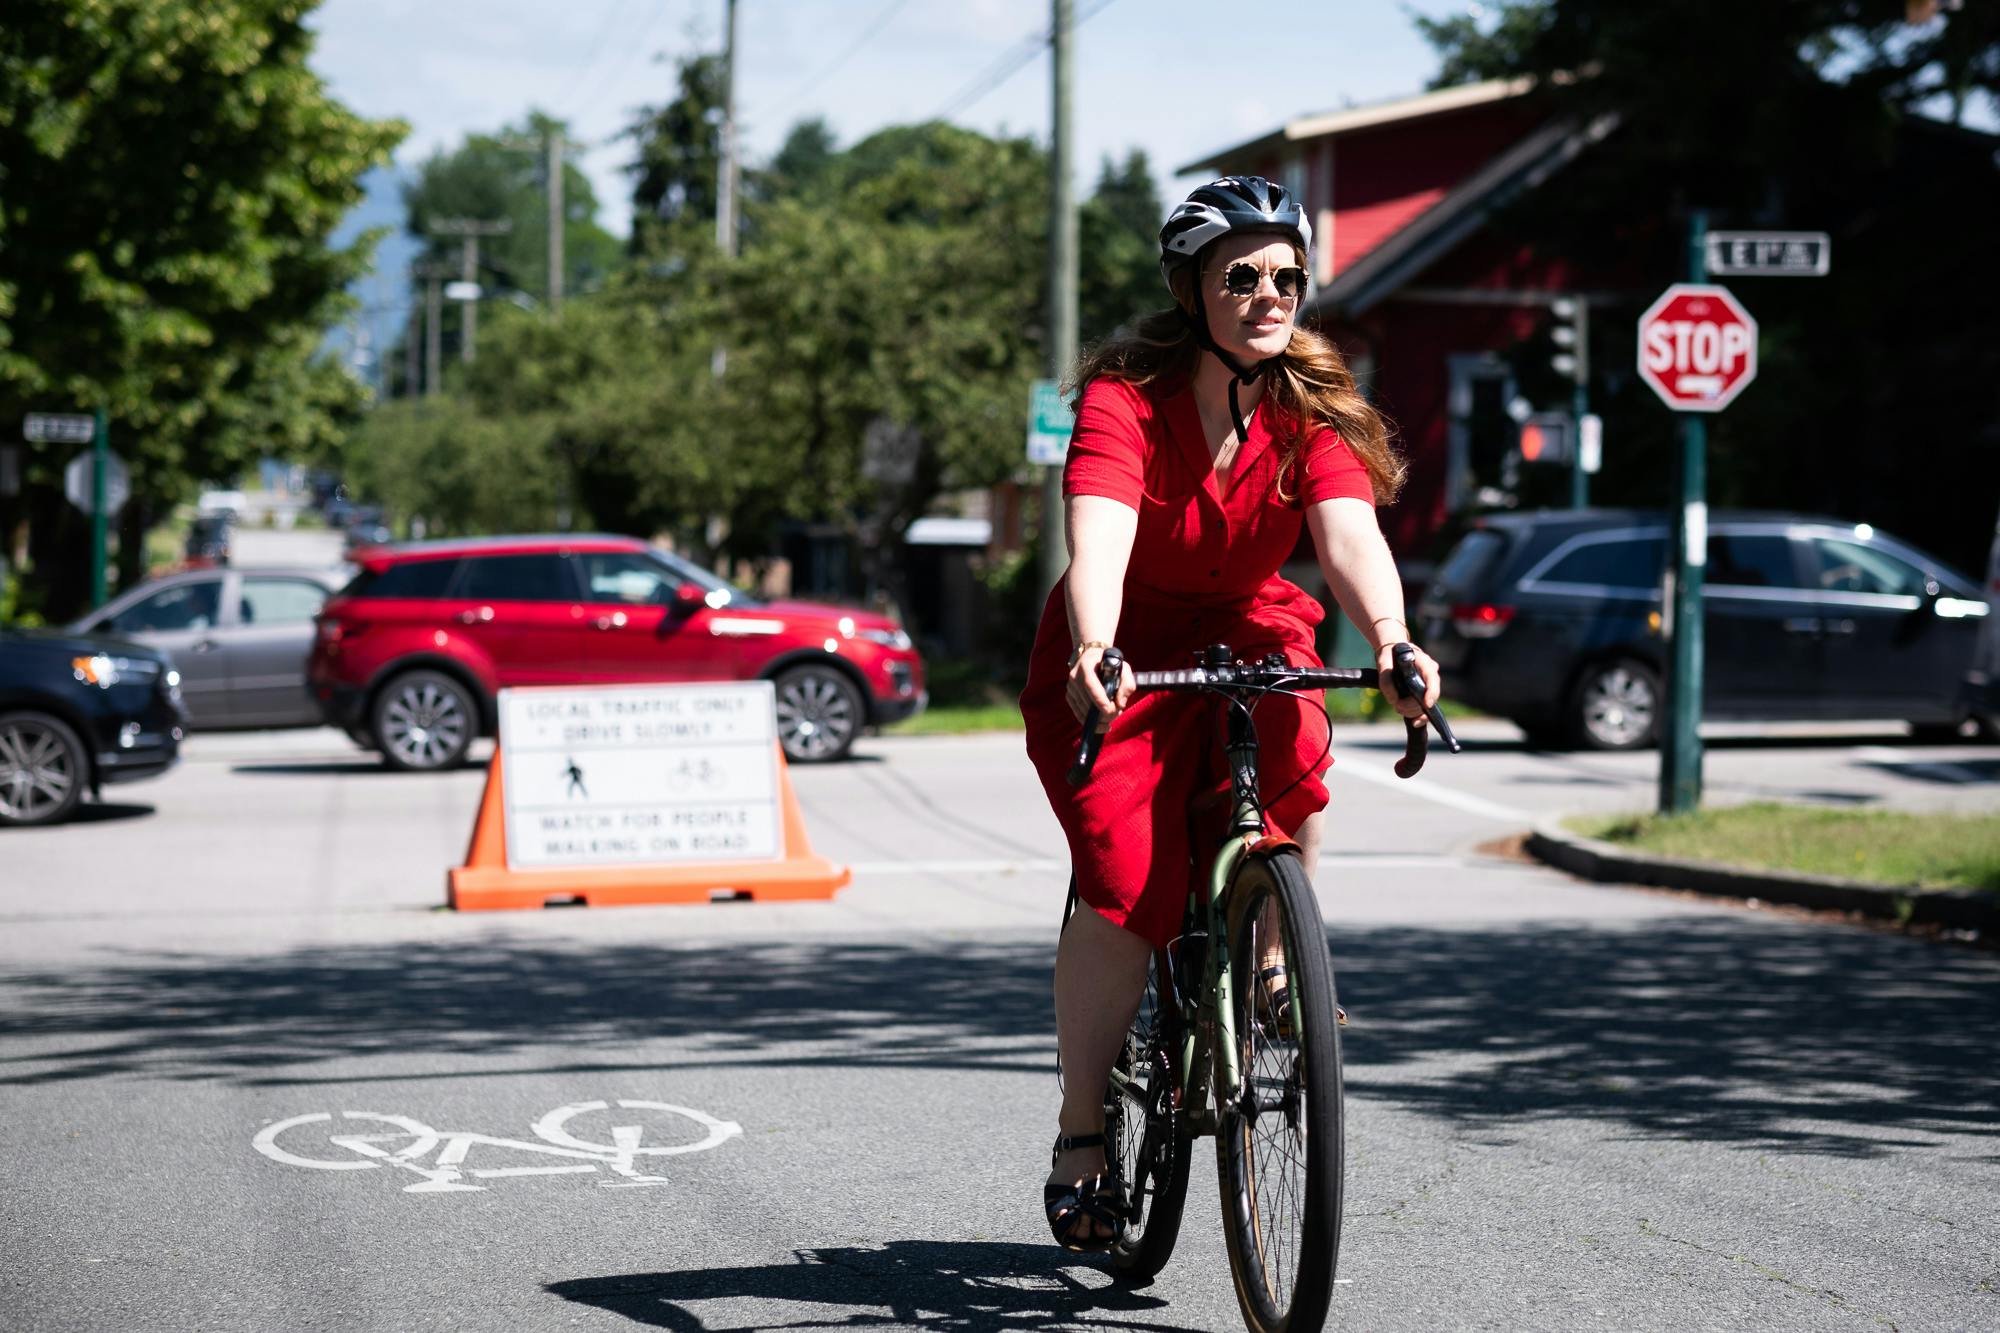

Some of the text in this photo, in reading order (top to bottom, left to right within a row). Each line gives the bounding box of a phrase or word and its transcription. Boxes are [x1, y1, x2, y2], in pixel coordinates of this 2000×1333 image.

[1646, 319, 1750, 375] STOP
[527, 697, 746, 720] LOCAL TRAFFIC ONLY
[563, 722, 713, 741] DRIVE SLOWLY
[540, 809, 749, 831] WATCH FOR PEOPLE
[544, 833, 749, 855] WALKING ON ROAD
